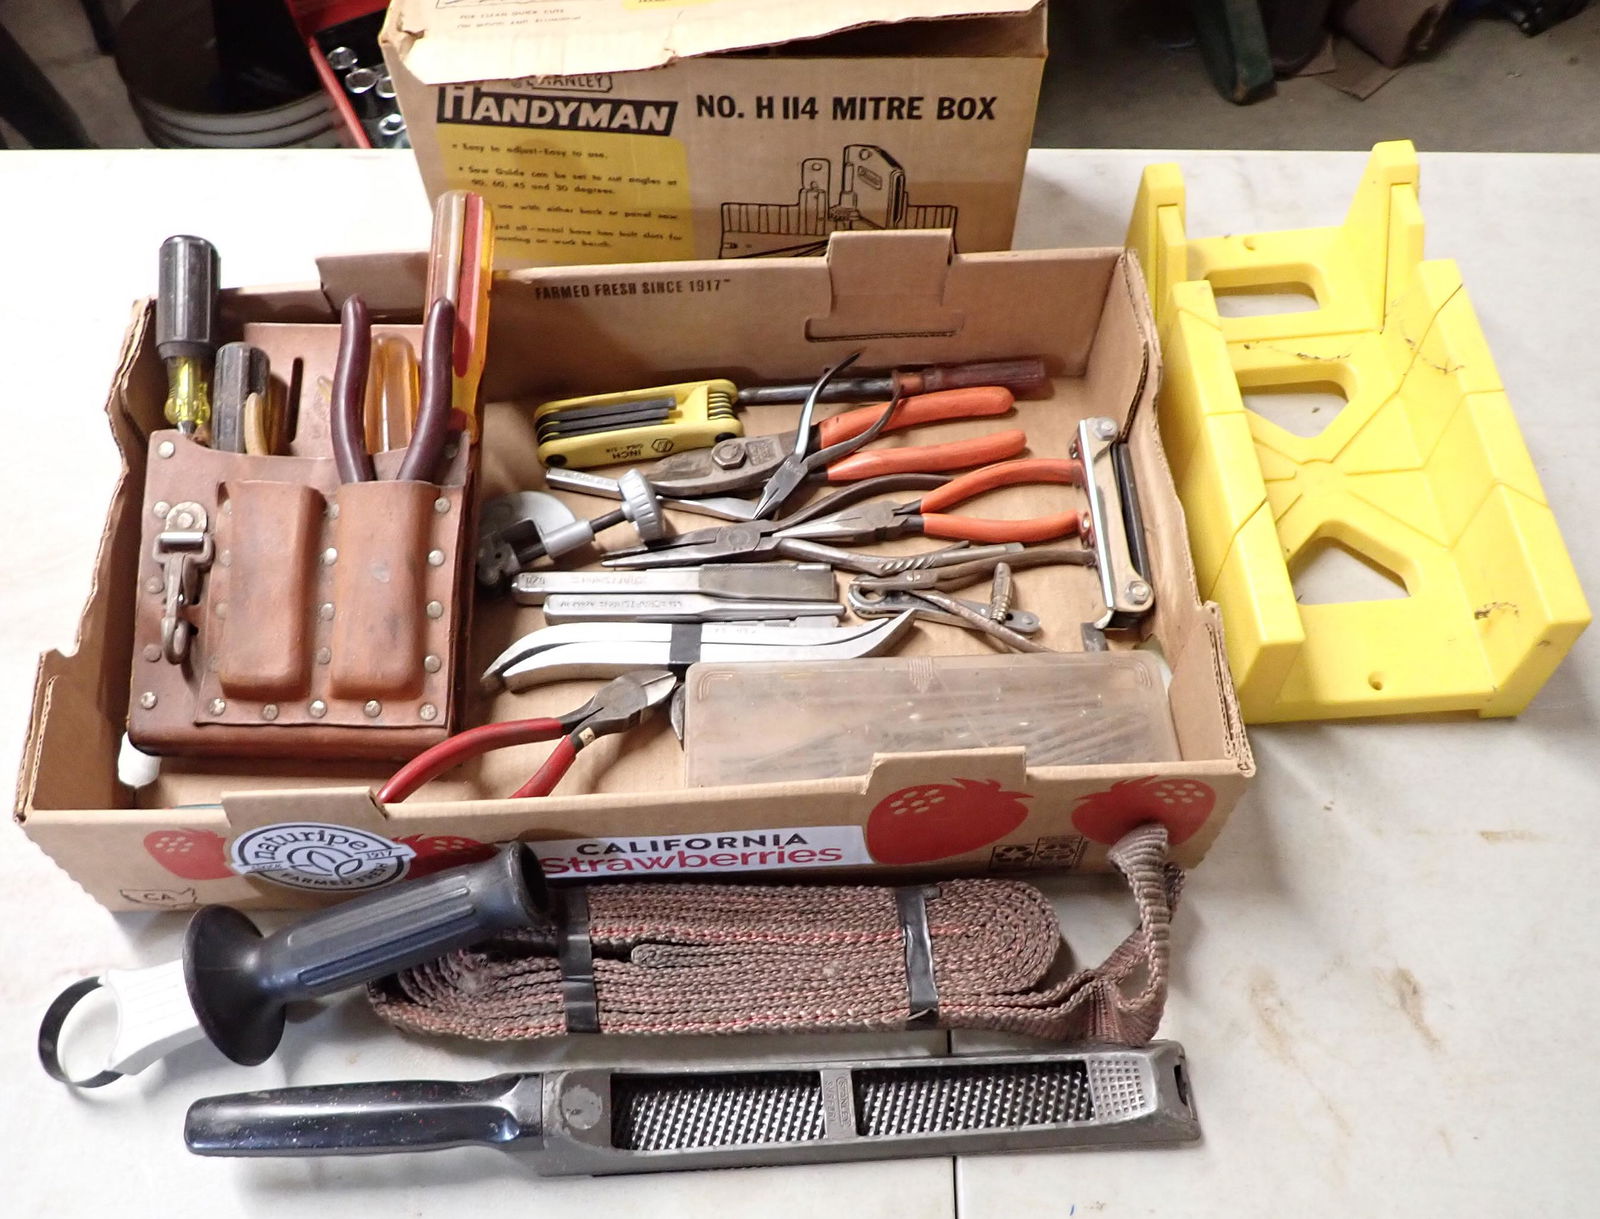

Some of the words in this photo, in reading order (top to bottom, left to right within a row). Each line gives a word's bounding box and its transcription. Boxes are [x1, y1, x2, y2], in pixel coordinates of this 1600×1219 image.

[541, 75, 604, 88] ANLEY
[444, 85, 670, 131] HANDYMAN
[695, 94, 744, 118] NO.
[832, 96, 925, 120] MITRE
[936, 96, 998, 120] BOX
[535, 284, 590, 299] FARMED
[594, 281, 637, 297] FRESH
[642, 279, 683, 294] SINCE
[253, 829, 369, 861] naturipe
[576, 832, 810, 856] CALIFORNIA
[281, 872, 352, 886] FARMED
